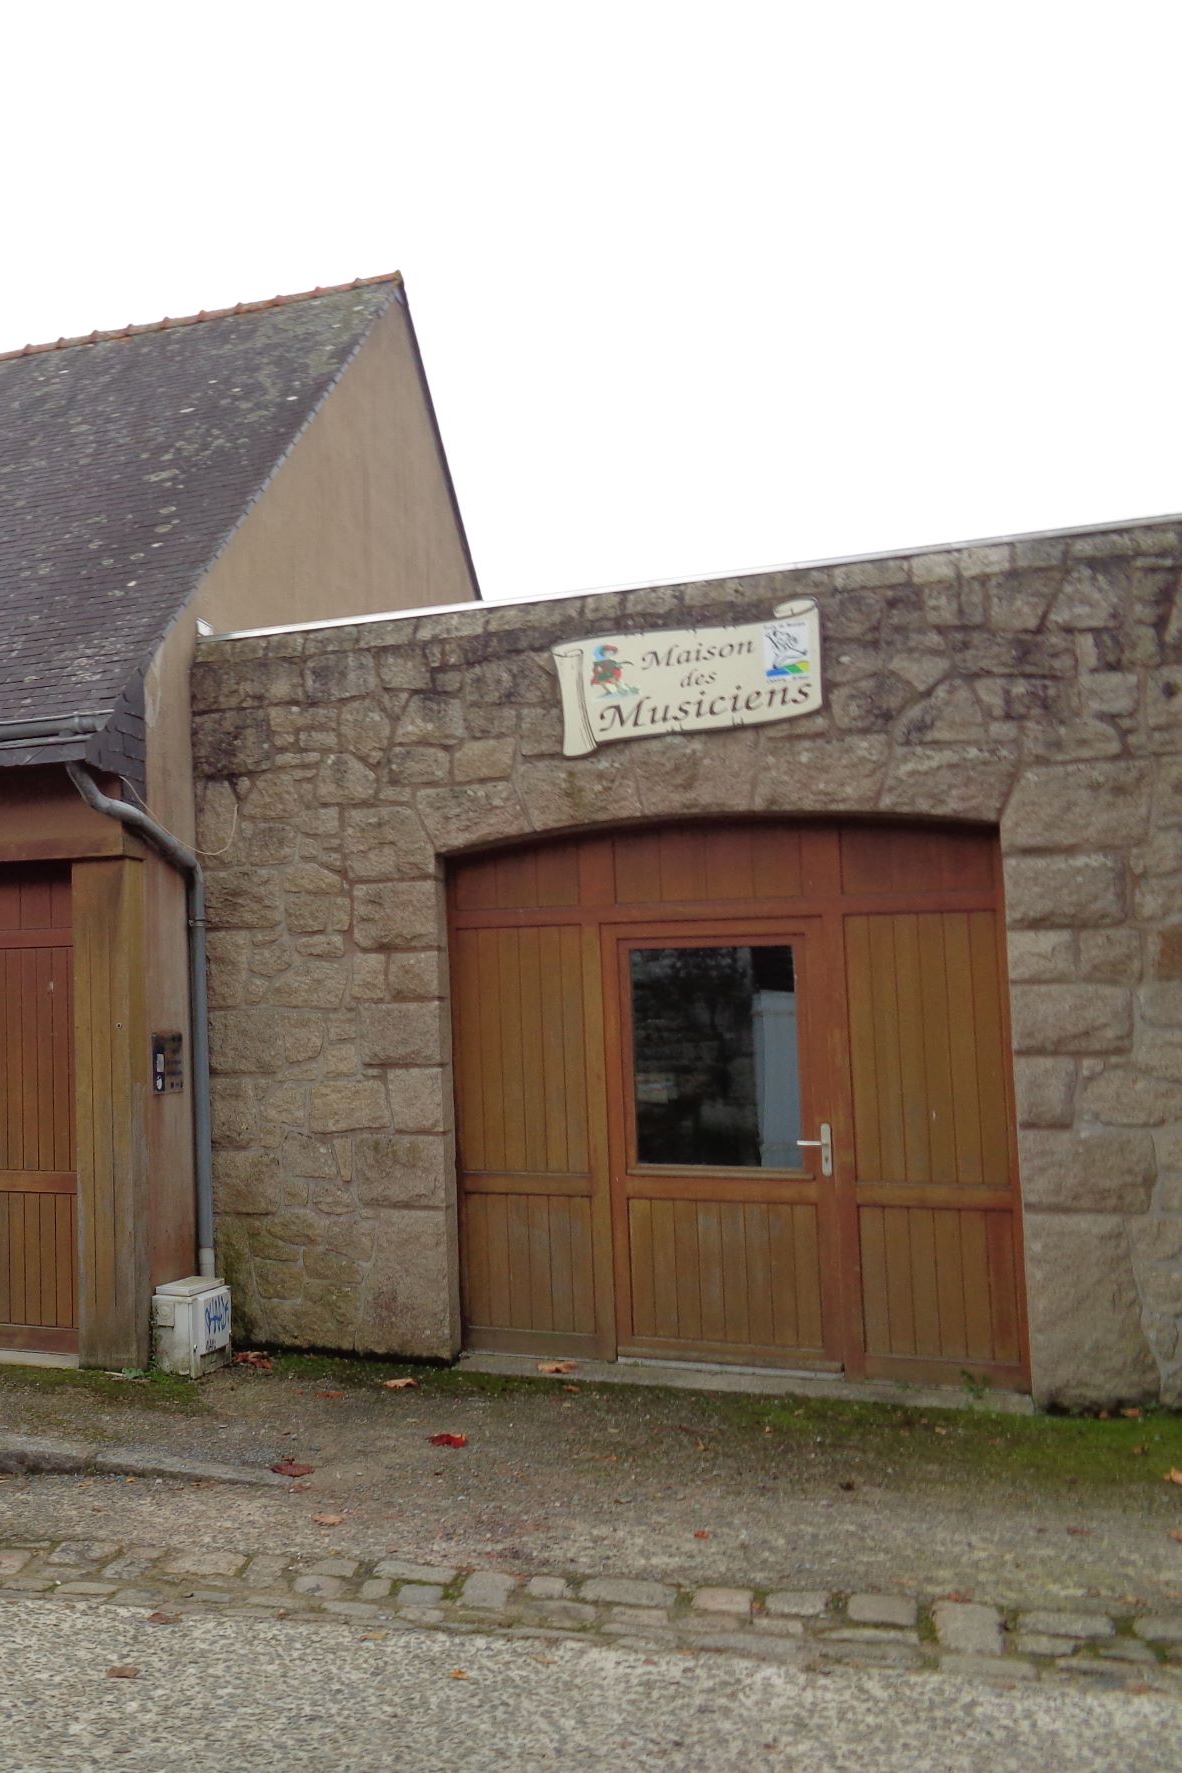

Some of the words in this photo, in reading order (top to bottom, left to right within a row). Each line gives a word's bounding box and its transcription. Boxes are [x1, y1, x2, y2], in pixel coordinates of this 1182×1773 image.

[641, 639, 753, 670] Maison
[680, 669, 717, 688] des
[600, 683, 812, 732] Musiciens
